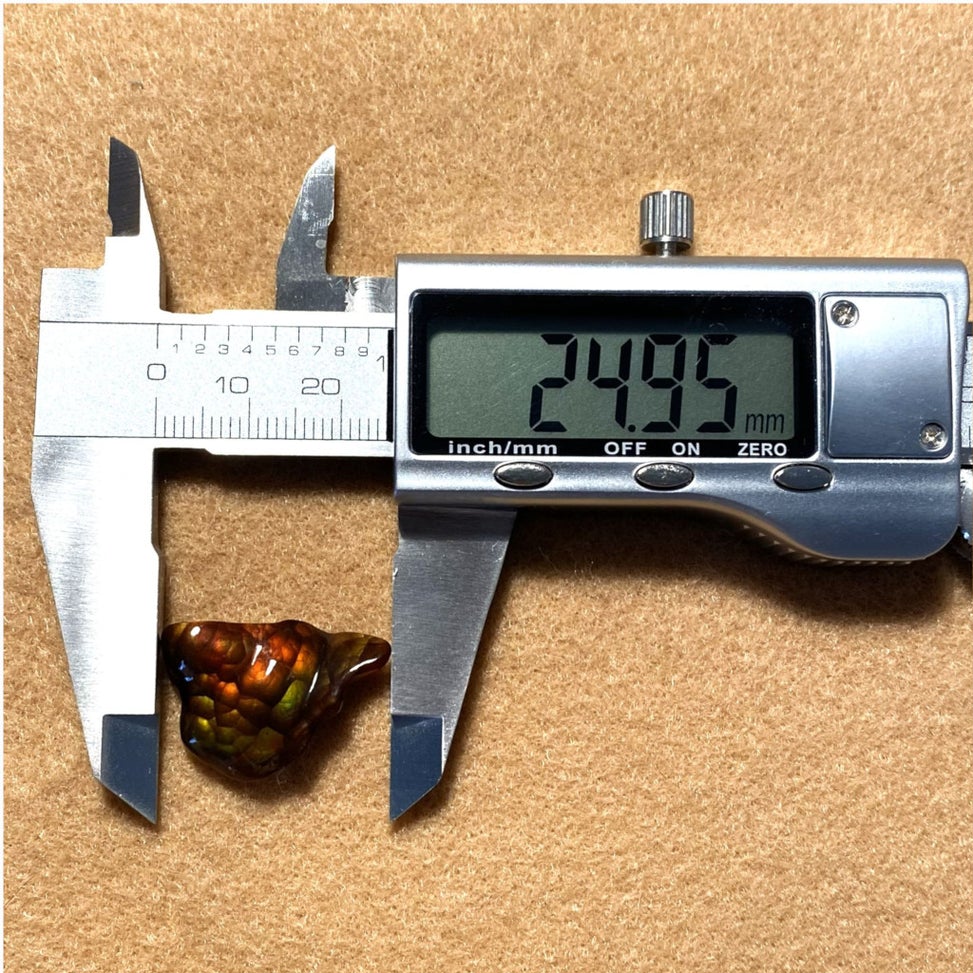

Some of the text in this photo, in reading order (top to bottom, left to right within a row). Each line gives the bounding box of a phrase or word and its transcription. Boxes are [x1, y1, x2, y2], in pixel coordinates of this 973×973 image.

[173, 344, 368, 356] 1 2 3 4 5 6 7 8 9
[147, 363, 340, 395] 0 10 20
[530, 333, 784, 434] 24.95 mm
[448, 440, 787, 456] inch/mm OFF ON ZERO
